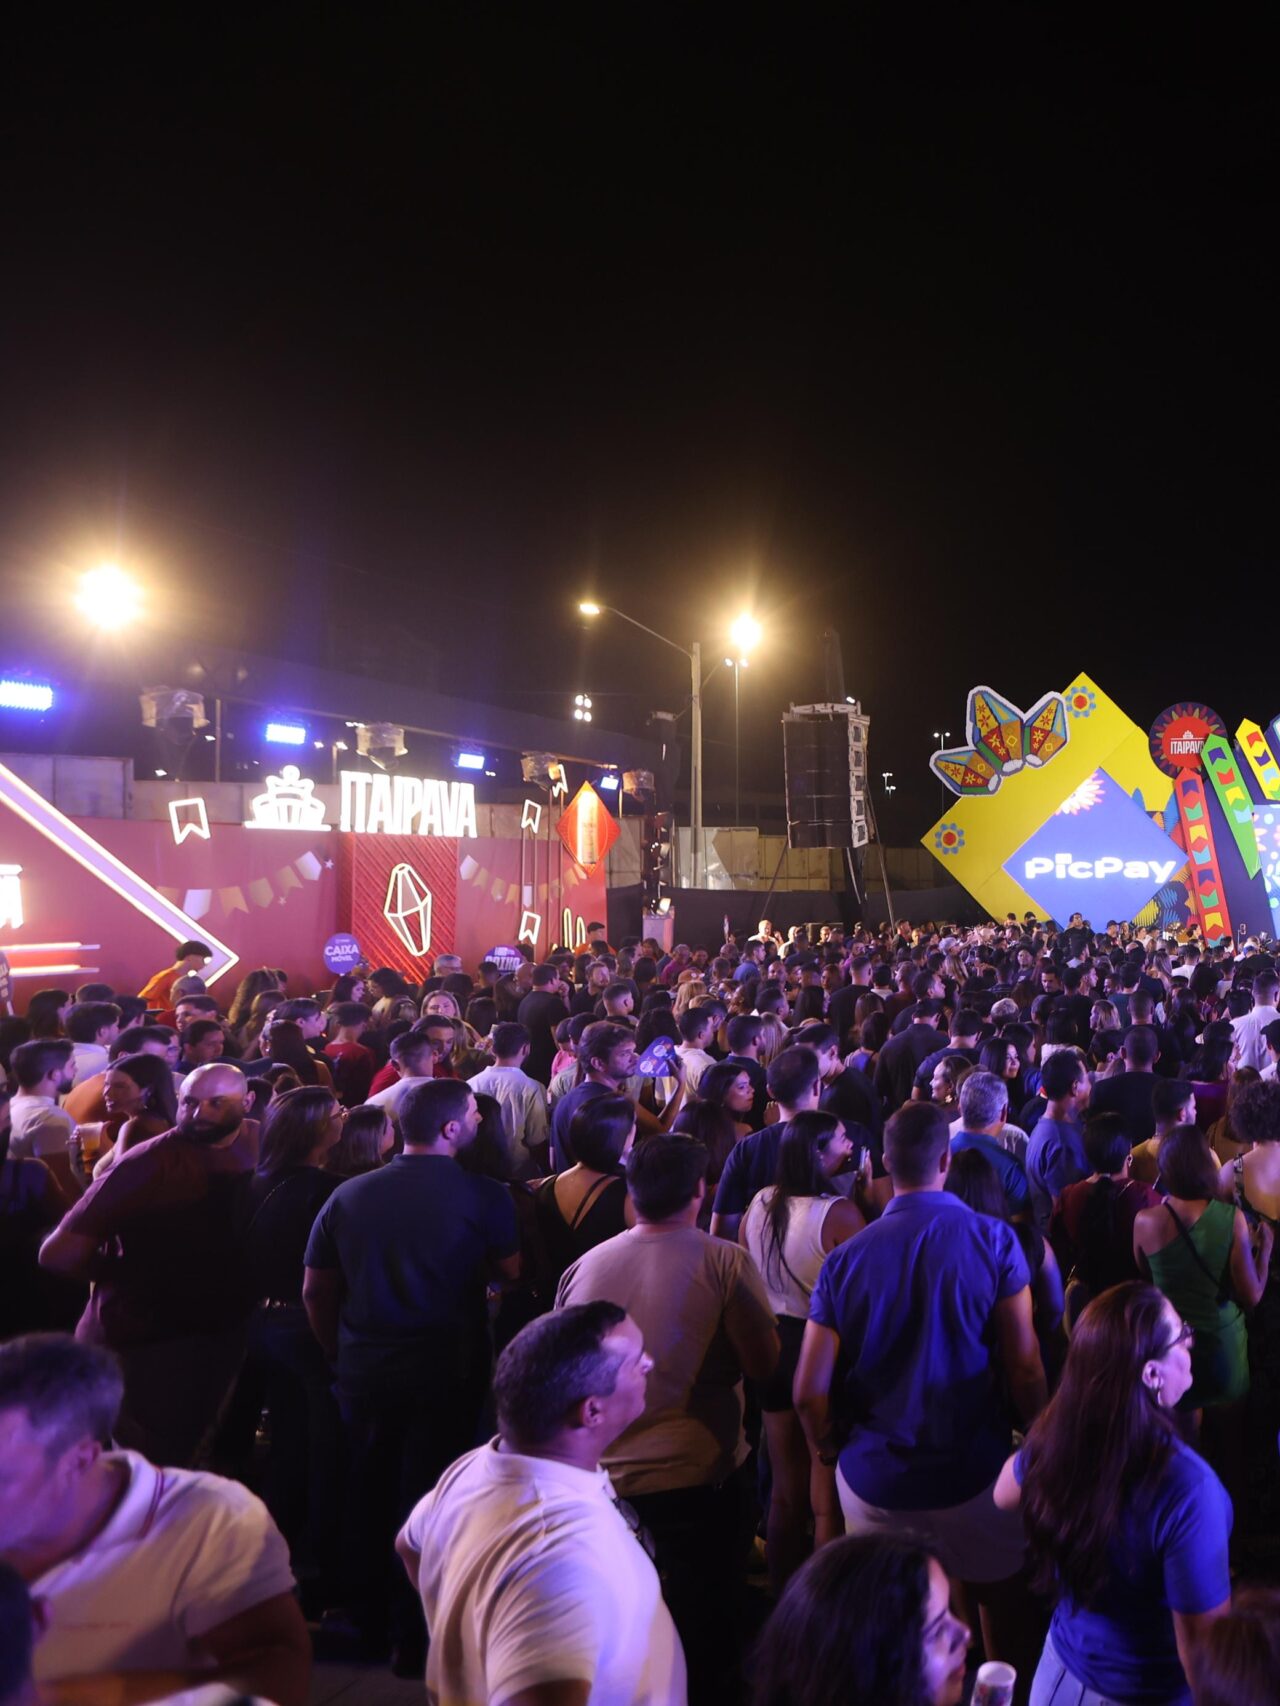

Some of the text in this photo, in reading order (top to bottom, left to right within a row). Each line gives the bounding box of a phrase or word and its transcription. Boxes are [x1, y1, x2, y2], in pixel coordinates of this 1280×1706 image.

[340, 770, 478, 838] ITAIPAVA
[1025, 853, 1177, 884] PicPay
[324, 944, 360, 956] CAIXA
